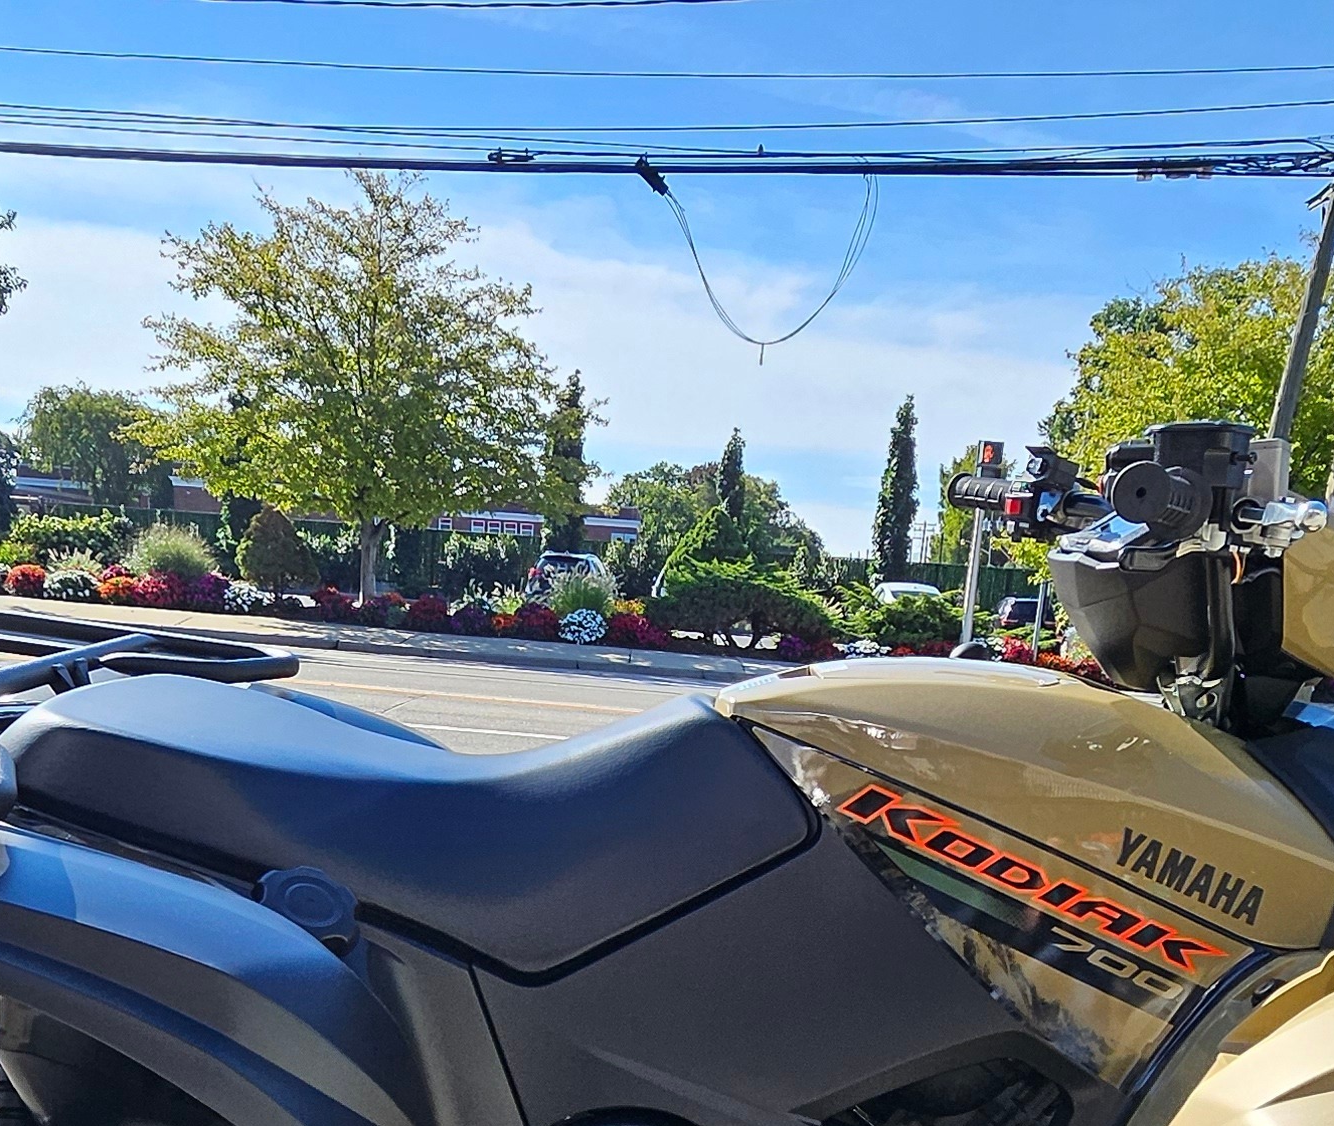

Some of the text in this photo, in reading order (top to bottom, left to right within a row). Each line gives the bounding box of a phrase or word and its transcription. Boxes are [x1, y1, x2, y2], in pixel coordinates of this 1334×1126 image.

[835, 783, 1230, 974] KODIAK
[1117, 826, 1266, 926] YAMAHA
[1051, 926, 1184, 1000] 700
